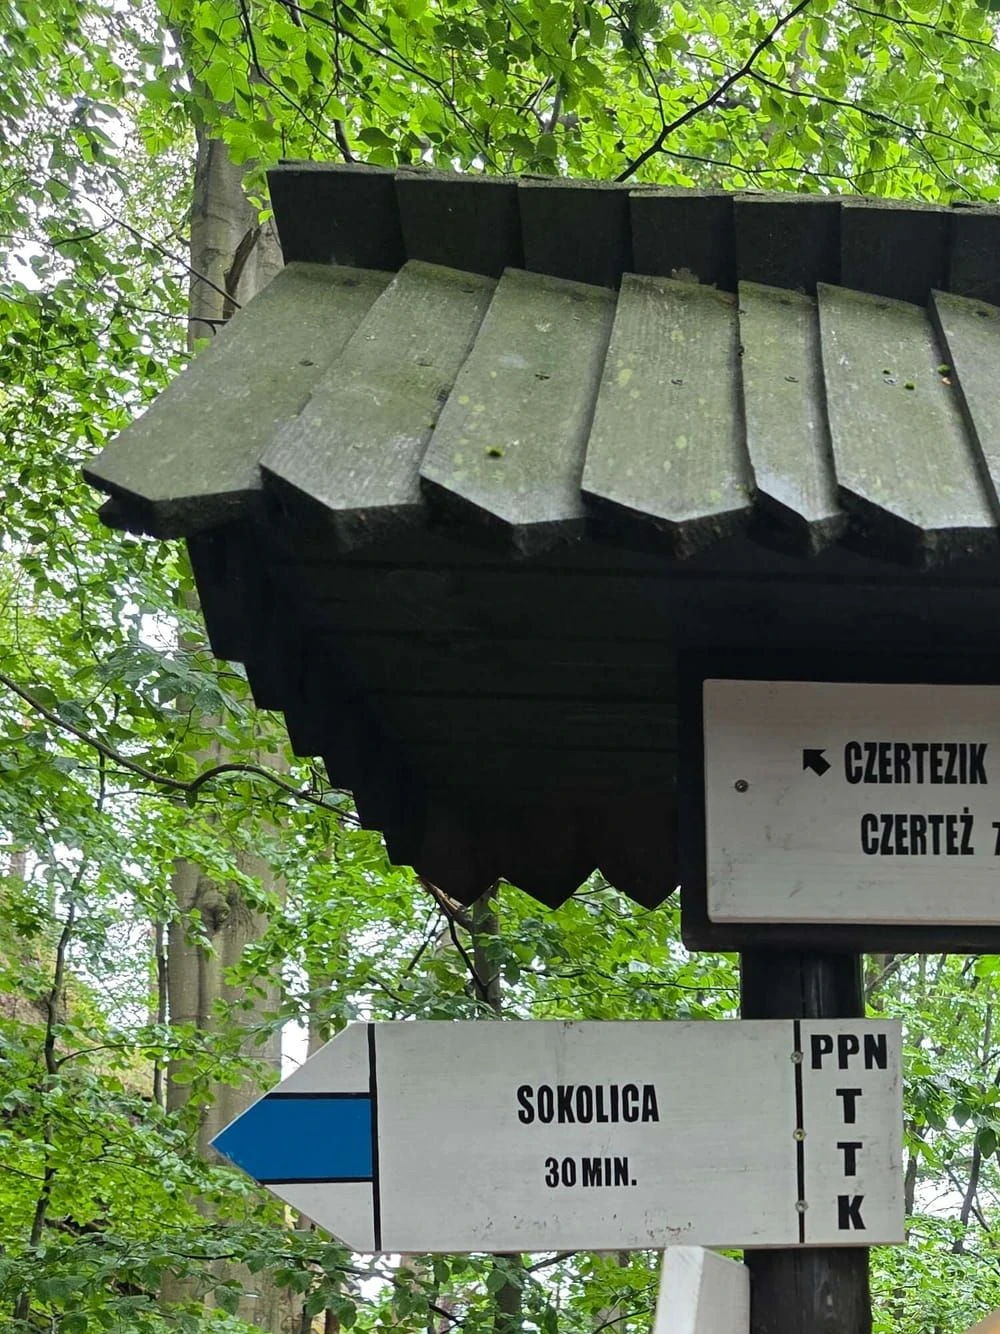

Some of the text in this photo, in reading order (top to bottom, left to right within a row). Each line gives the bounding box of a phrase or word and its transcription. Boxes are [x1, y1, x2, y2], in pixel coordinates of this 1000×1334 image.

[844, 741, 988, 785] CZERTEZIK
[861, 806, 974, 856] CZERTEŻ
[810, 1033, 888, 1071] PPN
[517, 1084, 660, 1125] SOKOLICA
[545, 1157, 638, 1188] 30 MIN.
